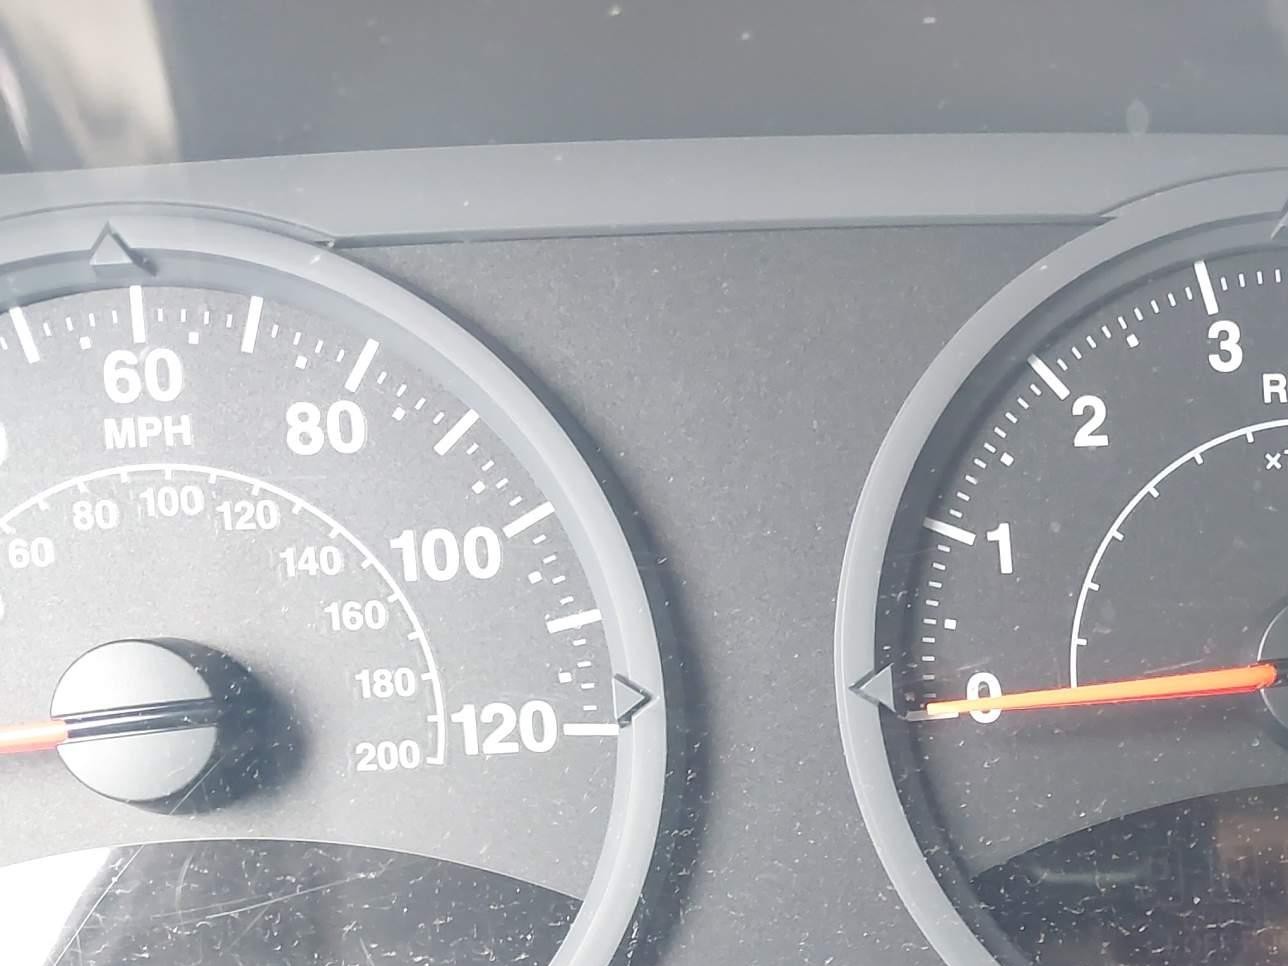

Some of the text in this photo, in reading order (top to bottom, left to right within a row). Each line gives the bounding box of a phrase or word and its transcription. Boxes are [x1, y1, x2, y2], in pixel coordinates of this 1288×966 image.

[1209, 319, 1243, 373] 3
[104, 349, 182, 402] 60
[104, 415, 191, 449] MPH
[286, 400, 365, 454] 80
[1072, 395, 1109, 447] 2
[73, 499, 118, 529] 80
[140, 485, 204, 516] 100
[216, 499, 280, 530] 120
[8, 537, 55, 568] 60
[279, 545, 342, 576] 140
[390, 527, 501, 582] 100
[986, 523, 1013, 574] 1
[324, 600, 386, 629] 160
[355, 667, 416, 698] 180
[966, 672, 1002, 724] 0
[451, 700, 557, 755] 120
[355, 740, 420, 770] 200
